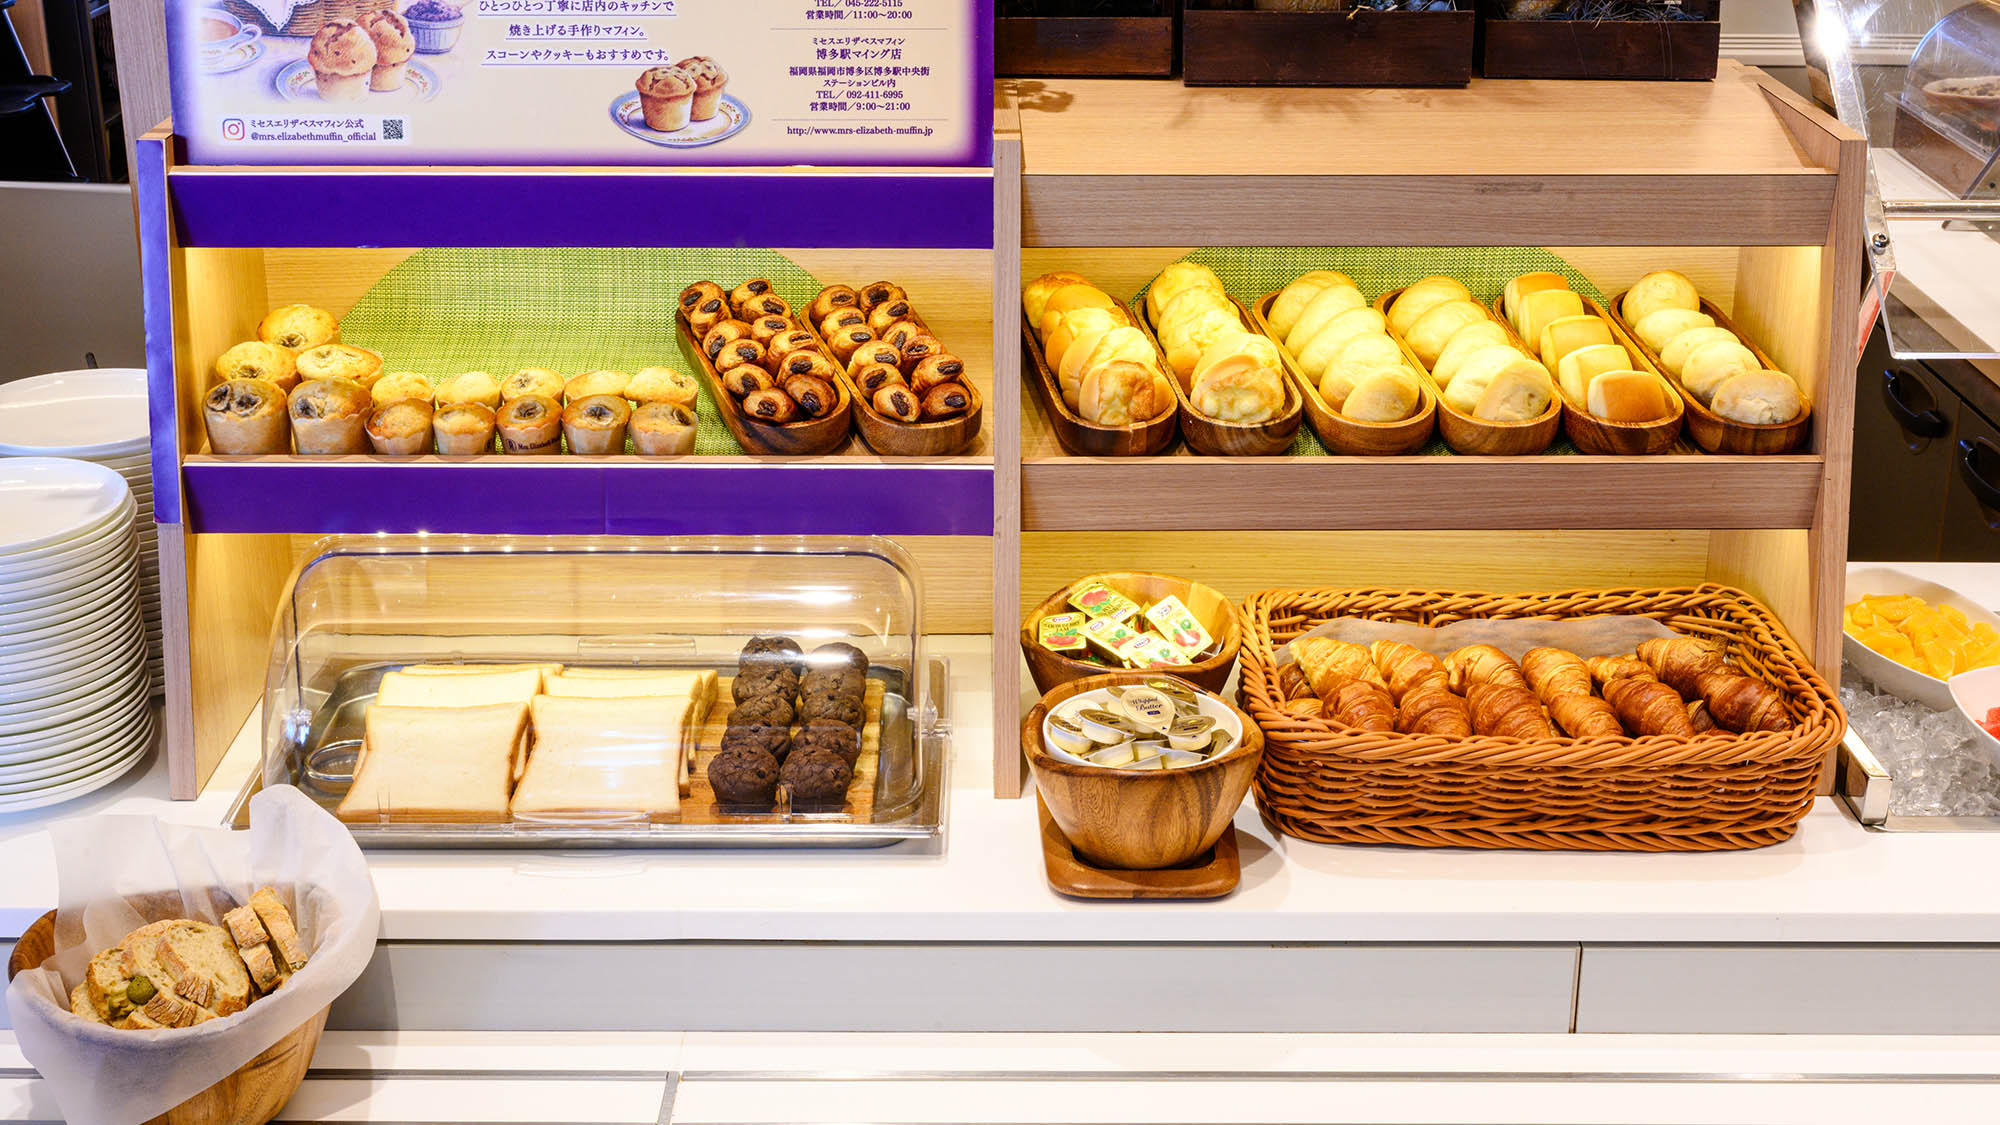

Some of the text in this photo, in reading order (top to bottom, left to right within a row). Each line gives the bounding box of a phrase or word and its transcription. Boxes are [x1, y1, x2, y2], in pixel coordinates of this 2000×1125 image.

[480, 0, 674, 12] ひとつひとつ丁寧に店内のキッチンで
[509, 24, 644, 36] 焼き上げる手作りマフィン。
[812, 37, 905, 46] ミセスエリザベスマフィン
[486, 49, 669, 62] スコーンやクッキーもおすすめです。
[816, 48, 902, 60] 博多駅マイング店
[789, 66, 930, 76] 福岡県福岡市博多区博多駅中央街
[823, 78, 896, 88] ステーションビル内
[846, 90, 903, 99] 092-411-6995
[251, 119, 364, 129] ミセスエリザベスマフィン公式
[787, 126, 933, 136] http://www.mrs-elizabeth-muffin.jp
[251, 132, 376, 142] @mrs.elizabethmuffin_official
